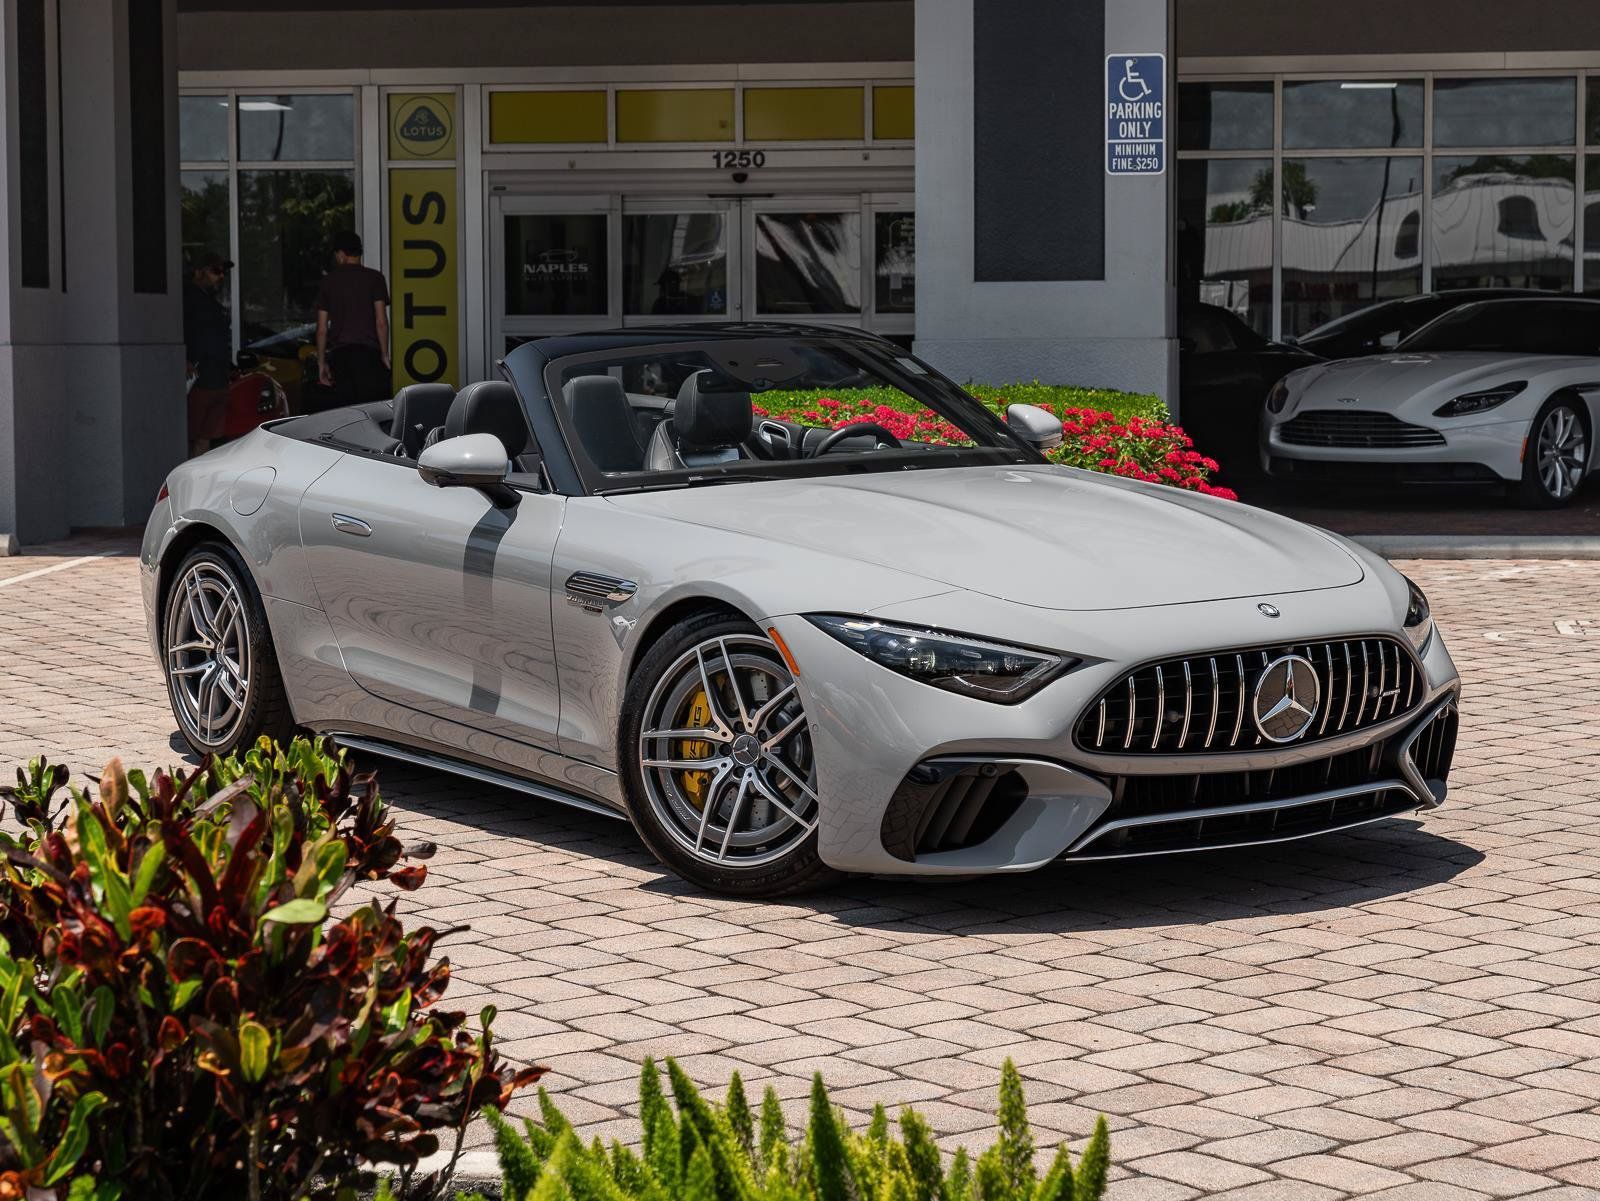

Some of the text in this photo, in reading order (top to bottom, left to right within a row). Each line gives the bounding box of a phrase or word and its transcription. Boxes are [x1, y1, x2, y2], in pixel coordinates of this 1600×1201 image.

[1109, 102, 1162, 118] PARKING
[403, 126, 444, 137] LOTUS
[1119, 121, 1152, 138] ONLY
[1115, 143, 1156, 156] MINIMUM
[712, 151, 766, 169] 1250
[1112, 157, 1159, 171] FINE $250
[523, 263, 589, 274] NAPLES
[402, 191, 448, 383] OTUS
